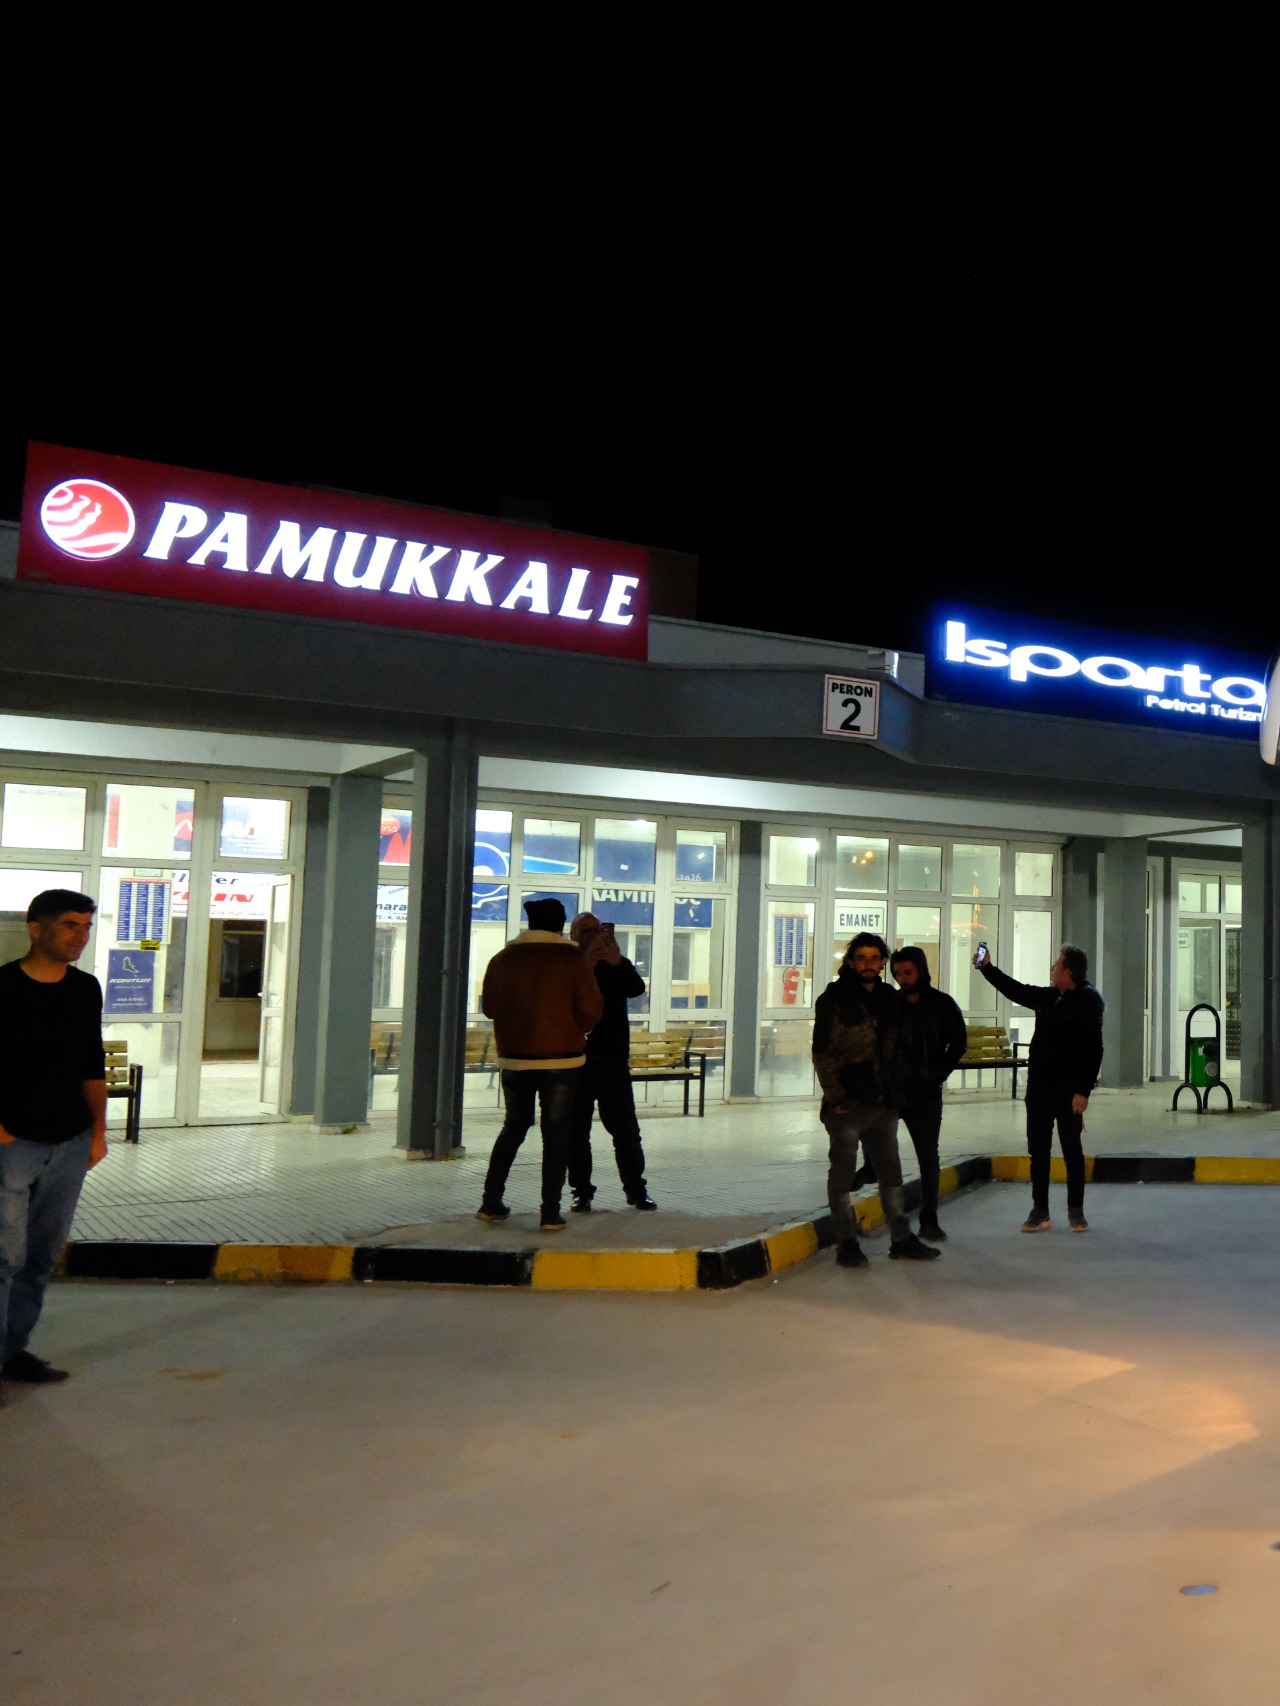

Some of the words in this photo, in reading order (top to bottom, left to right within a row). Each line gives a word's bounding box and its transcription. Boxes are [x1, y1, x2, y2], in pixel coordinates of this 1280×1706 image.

[143, 501, 640, 626] PAMUKKALE
[945, 620, 1267, 707] Isparta
[831, 682, 873, 698] PERON
[840, 698, 861, 732] 2
[1146, 695, 1206, 714] Petrol
[839, 913, 880, 928] EMANET
